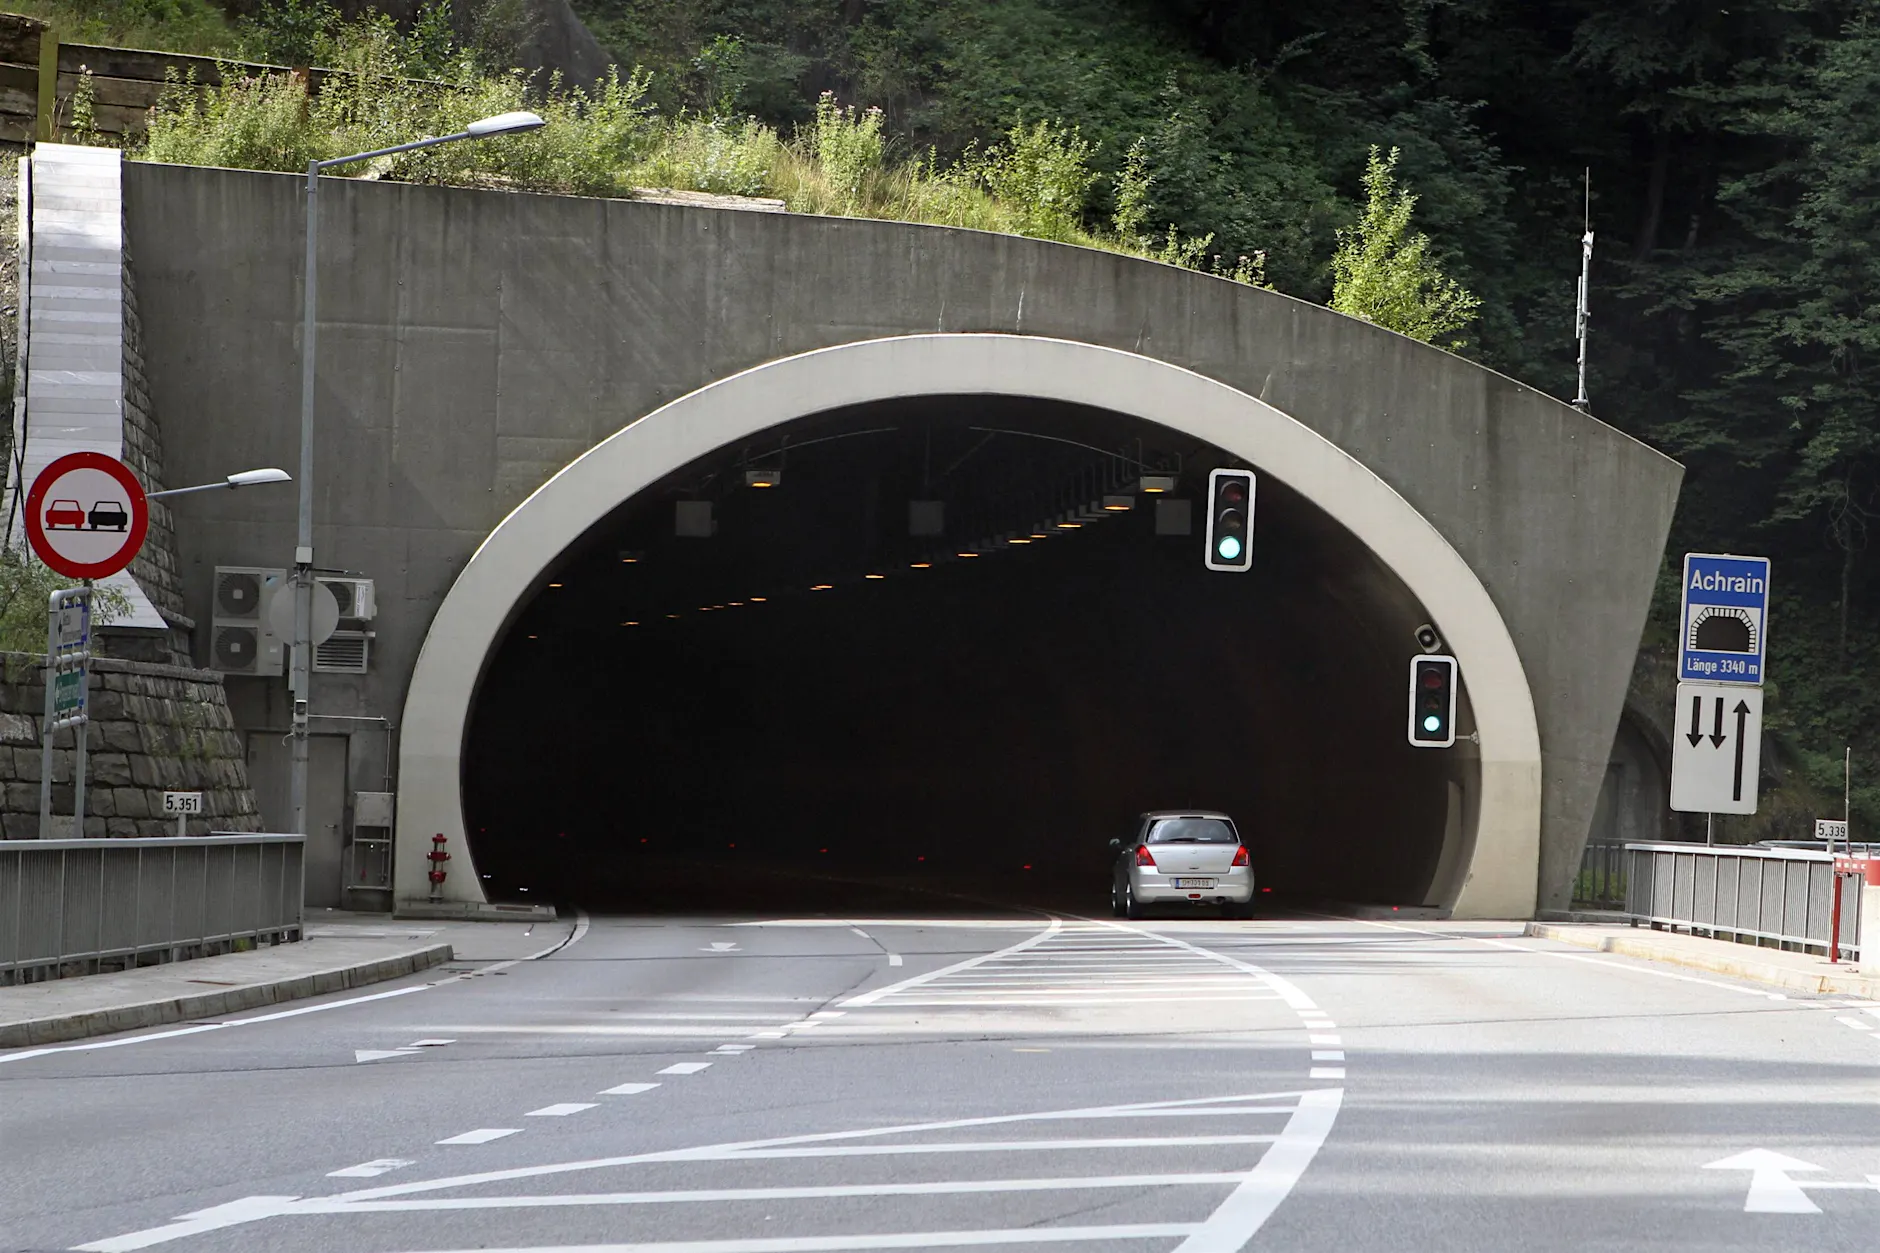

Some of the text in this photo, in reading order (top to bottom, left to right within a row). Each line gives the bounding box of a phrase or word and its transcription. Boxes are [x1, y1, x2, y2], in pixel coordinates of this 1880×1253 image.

[1690, 570, 1763, 593] Achrain
[1687, 658, 1758, 675] Länge 3340 m
